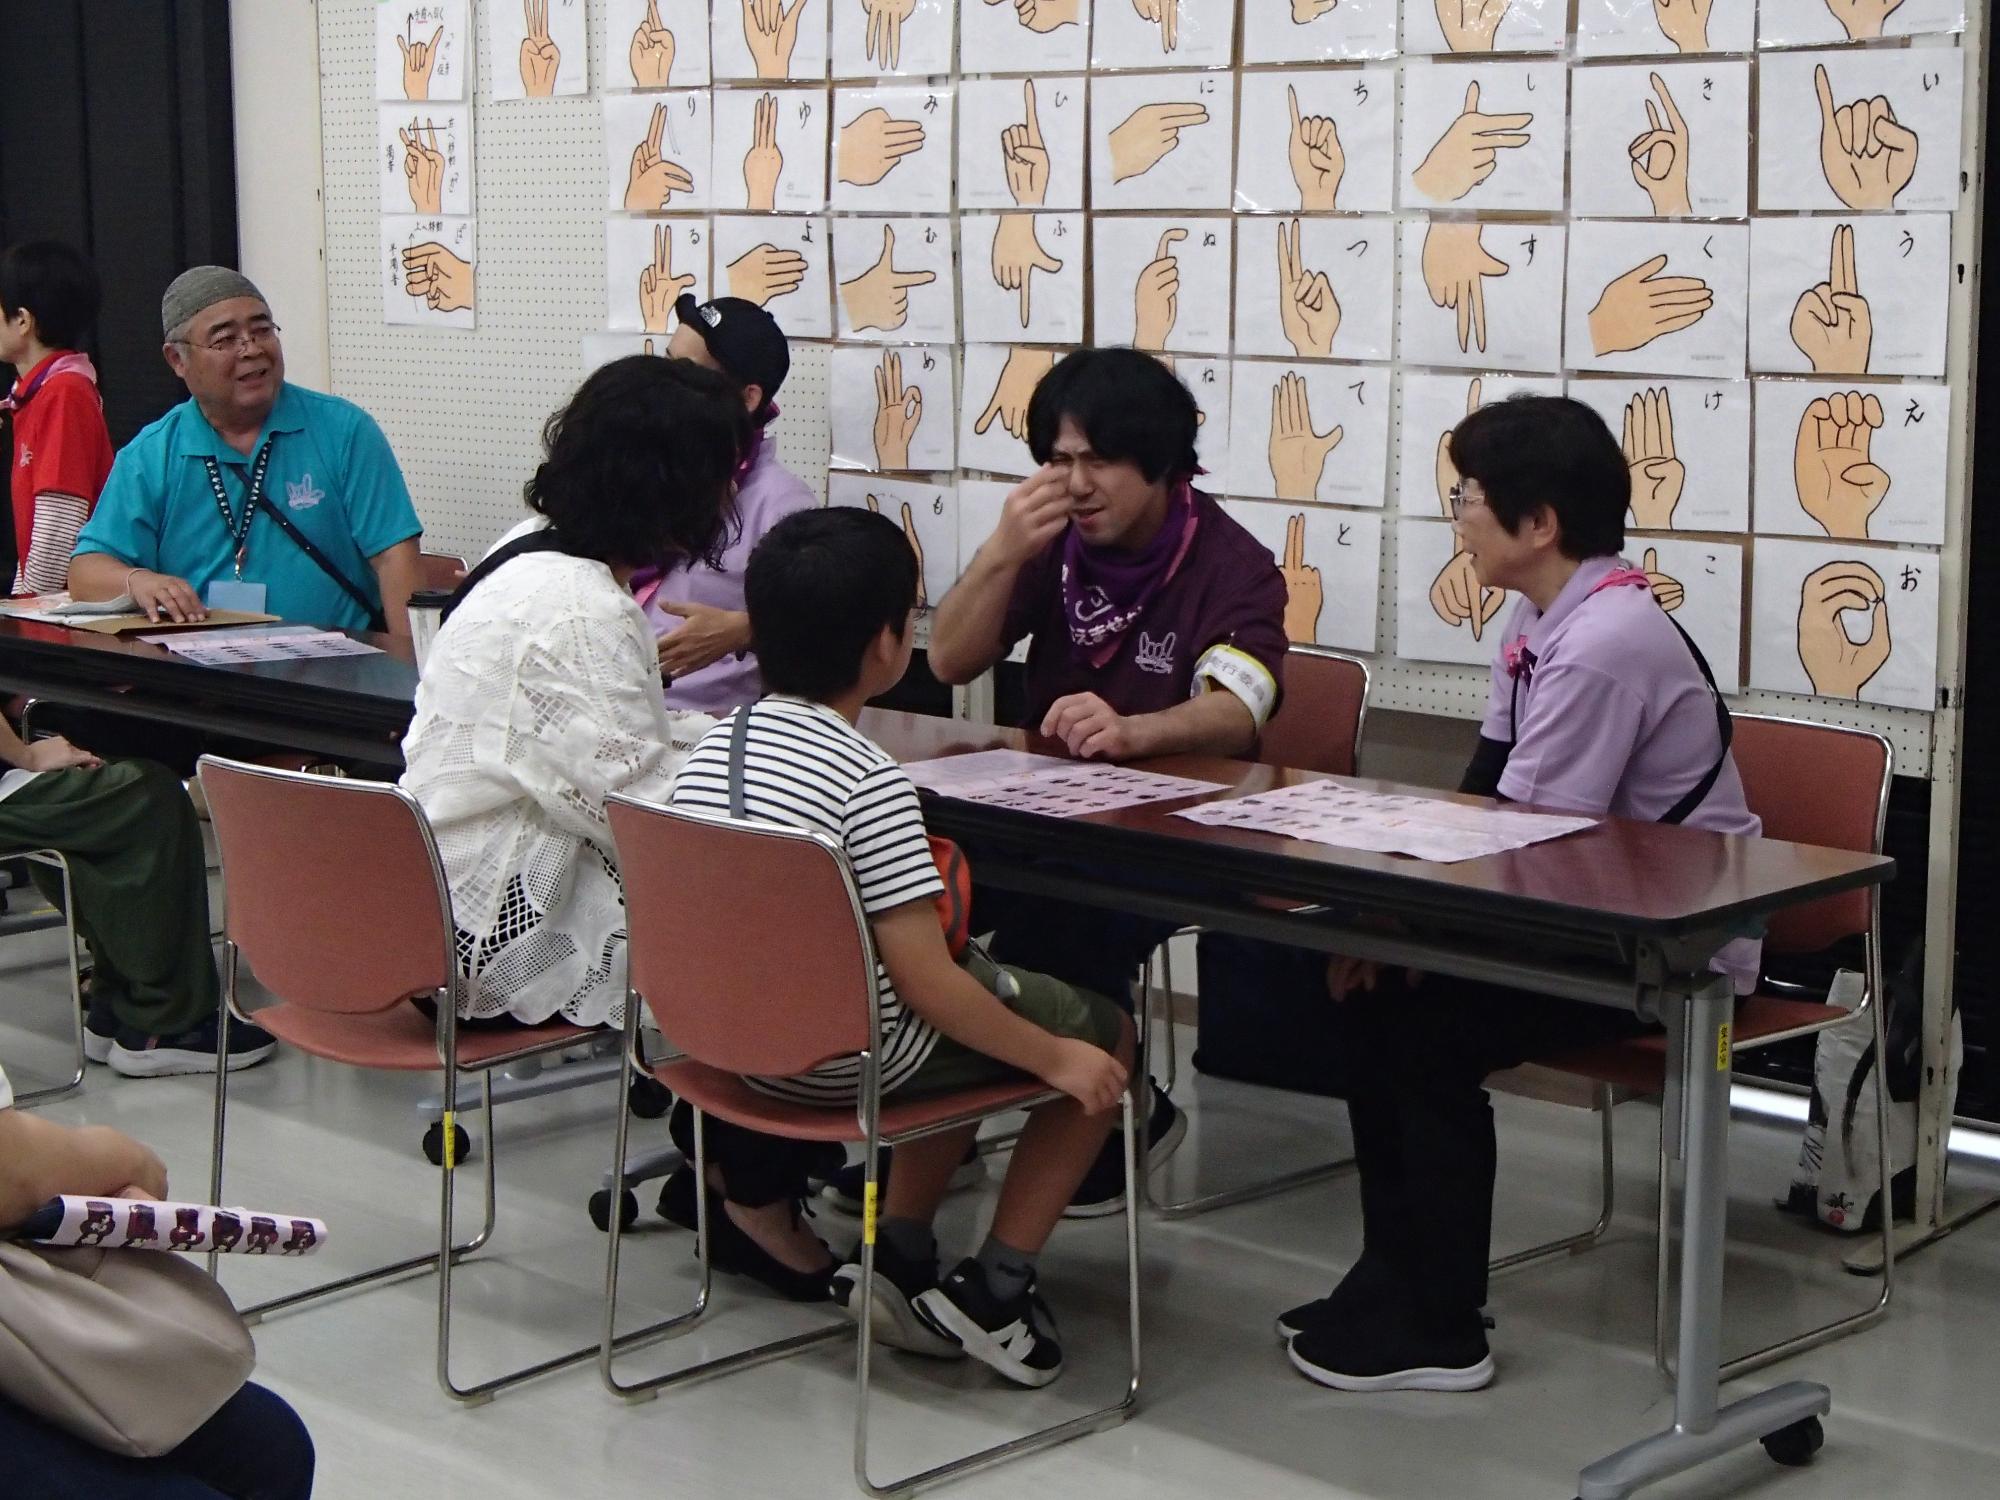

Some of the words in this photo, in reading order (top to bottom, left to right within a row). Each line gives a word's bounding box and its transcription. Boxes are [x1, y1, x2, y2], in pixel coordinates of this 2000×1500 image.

[1200, 80, 1214, 94] に
[1527, 74, 1535, 91] し
[1703, 78, 1713, 100] き
[1923, 73, 1939, 91] い
[1354, 80, 1368, 105] ち
[924, 95, 938, 114] み
[800, 102, 811, 128] ゆ
[690, 229, 700, 244] る
[801, 220, 813, 243] よ
[925, 227, 937, 243] む
[1054, 220, 1066, 236] ふ
[1203, 232, 1216, 246] ぬ
[1347, 240, 1368, 257] つ
[1703, 236, 1712, 258] く
[1899, 230, 1914, 257] う
[1520, 234, 1537, 266] す
[923, 351, 935, 371] め
[1203, 369, 1215, 383] ね
[1349, 381, 1364, 405] て
[1705, 391, 1723, 410] け
[1904, 398, 1924, 427] え
[1337, 523, 1351, 545] と
[1706, 556, 1716, 574] こ
[1901, 564, 1921, 592] お
